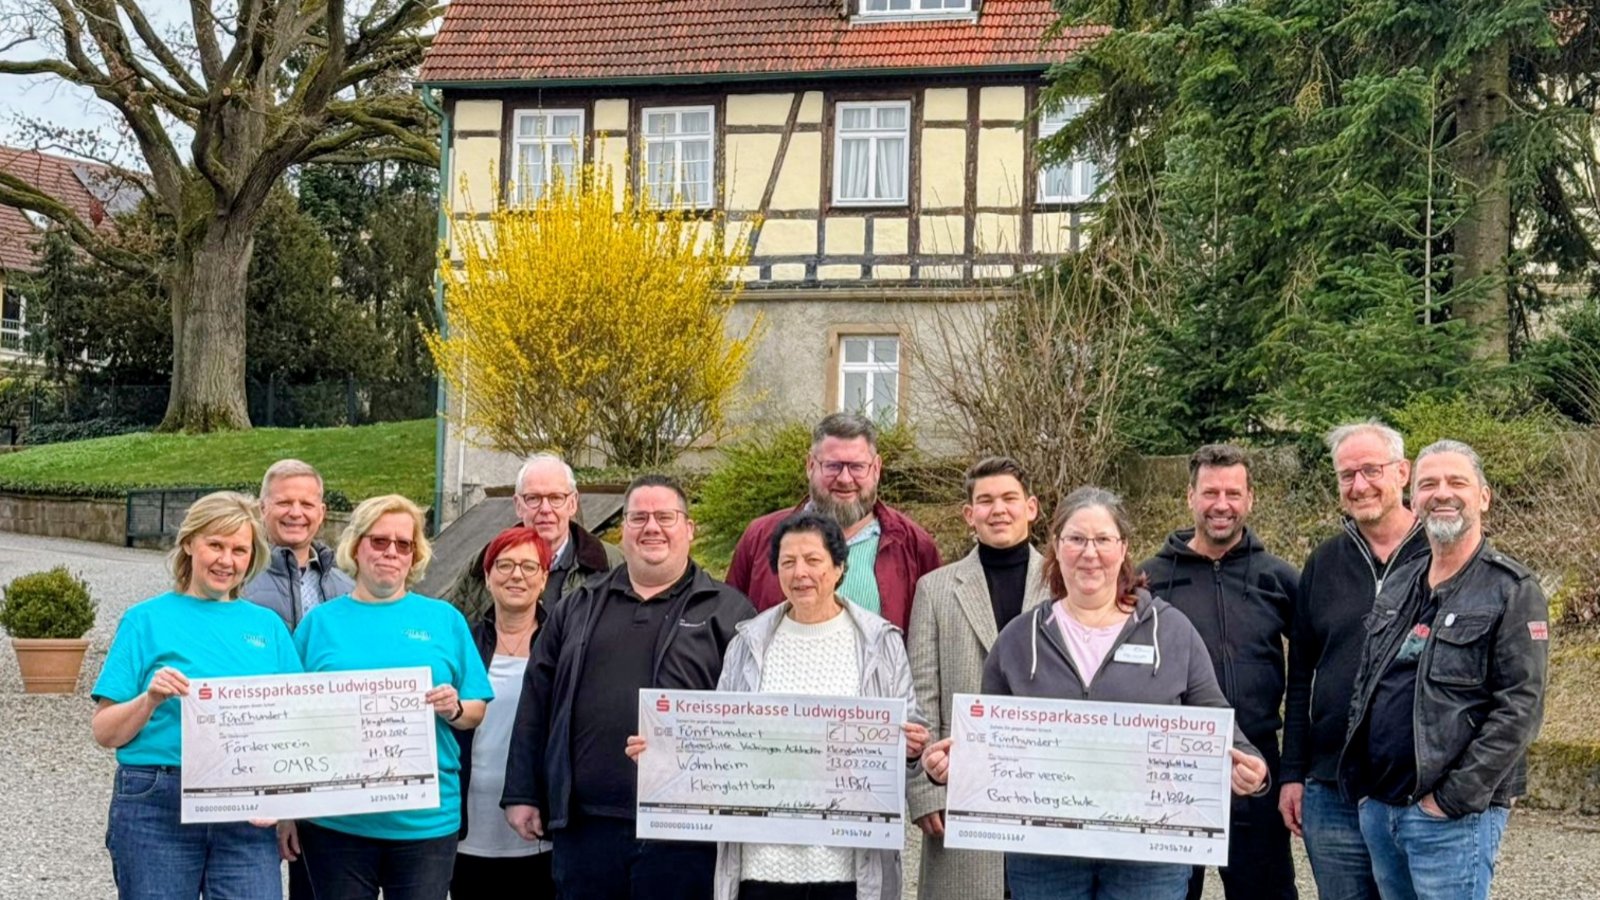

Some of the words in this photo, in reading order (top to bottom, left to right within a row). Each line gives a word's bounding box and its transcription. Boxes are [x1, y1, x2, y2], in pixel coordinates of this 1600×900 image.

[218, 683, 325, 700] Kreissparkasse
[328, 677, 417, 695] Ludwigsburg
[676, 699, 789, 717] Kreissparkasse
[794, 703, 891, 724] Ludwigsburg
[990, 704, 1108, 726] Kreissparkasse
[1113, 712, 1216, 735] Ludwigsburg
[679, 723, 763, 737] Fünfhundert
[231, 758, 256, 776] der
[273, 756, 329, 773] OMRS
[676, 754, 749, 771] Wohnheim
[690, 777, 775, 795] Kleinglattbach
